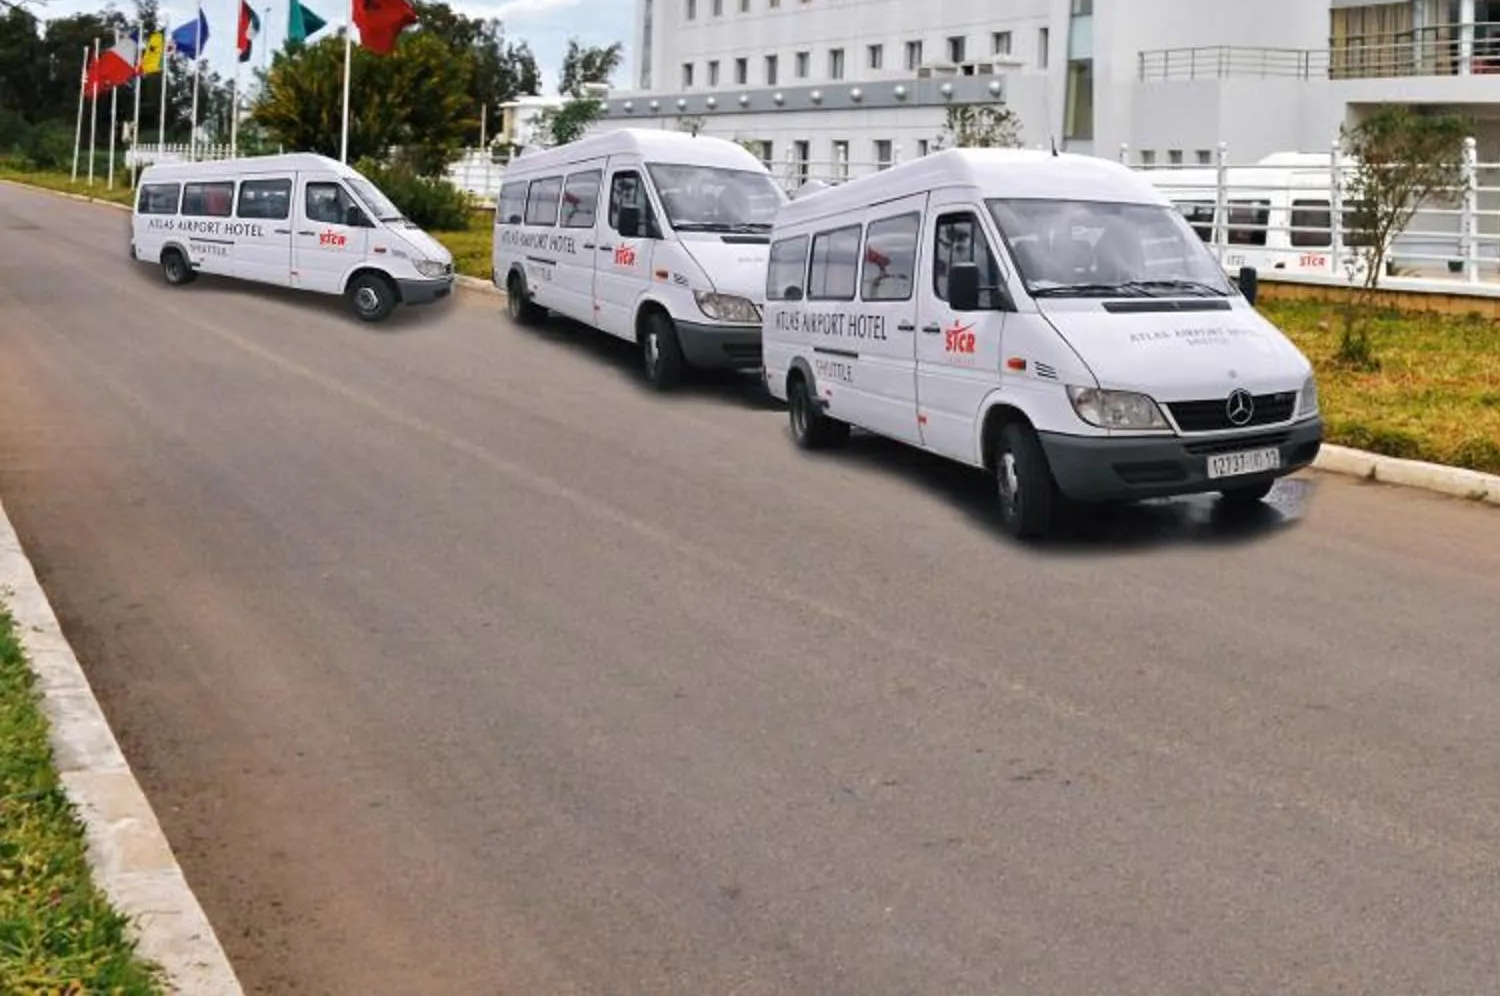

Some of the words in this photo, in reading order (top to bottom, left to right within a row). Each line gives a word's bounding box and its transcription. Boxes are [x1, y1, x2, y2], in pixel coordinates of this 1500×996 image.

[149, 219, 174, 231] ATLAS
[179, 220, 220, 235] AIRPORT
[224, 223, 264, 237] HOTEL
[776, 310, 801, 331] ATLAS
[802, 312, 845, 337] AIRPORT
[847, 313, 887, 341] HOTEL
